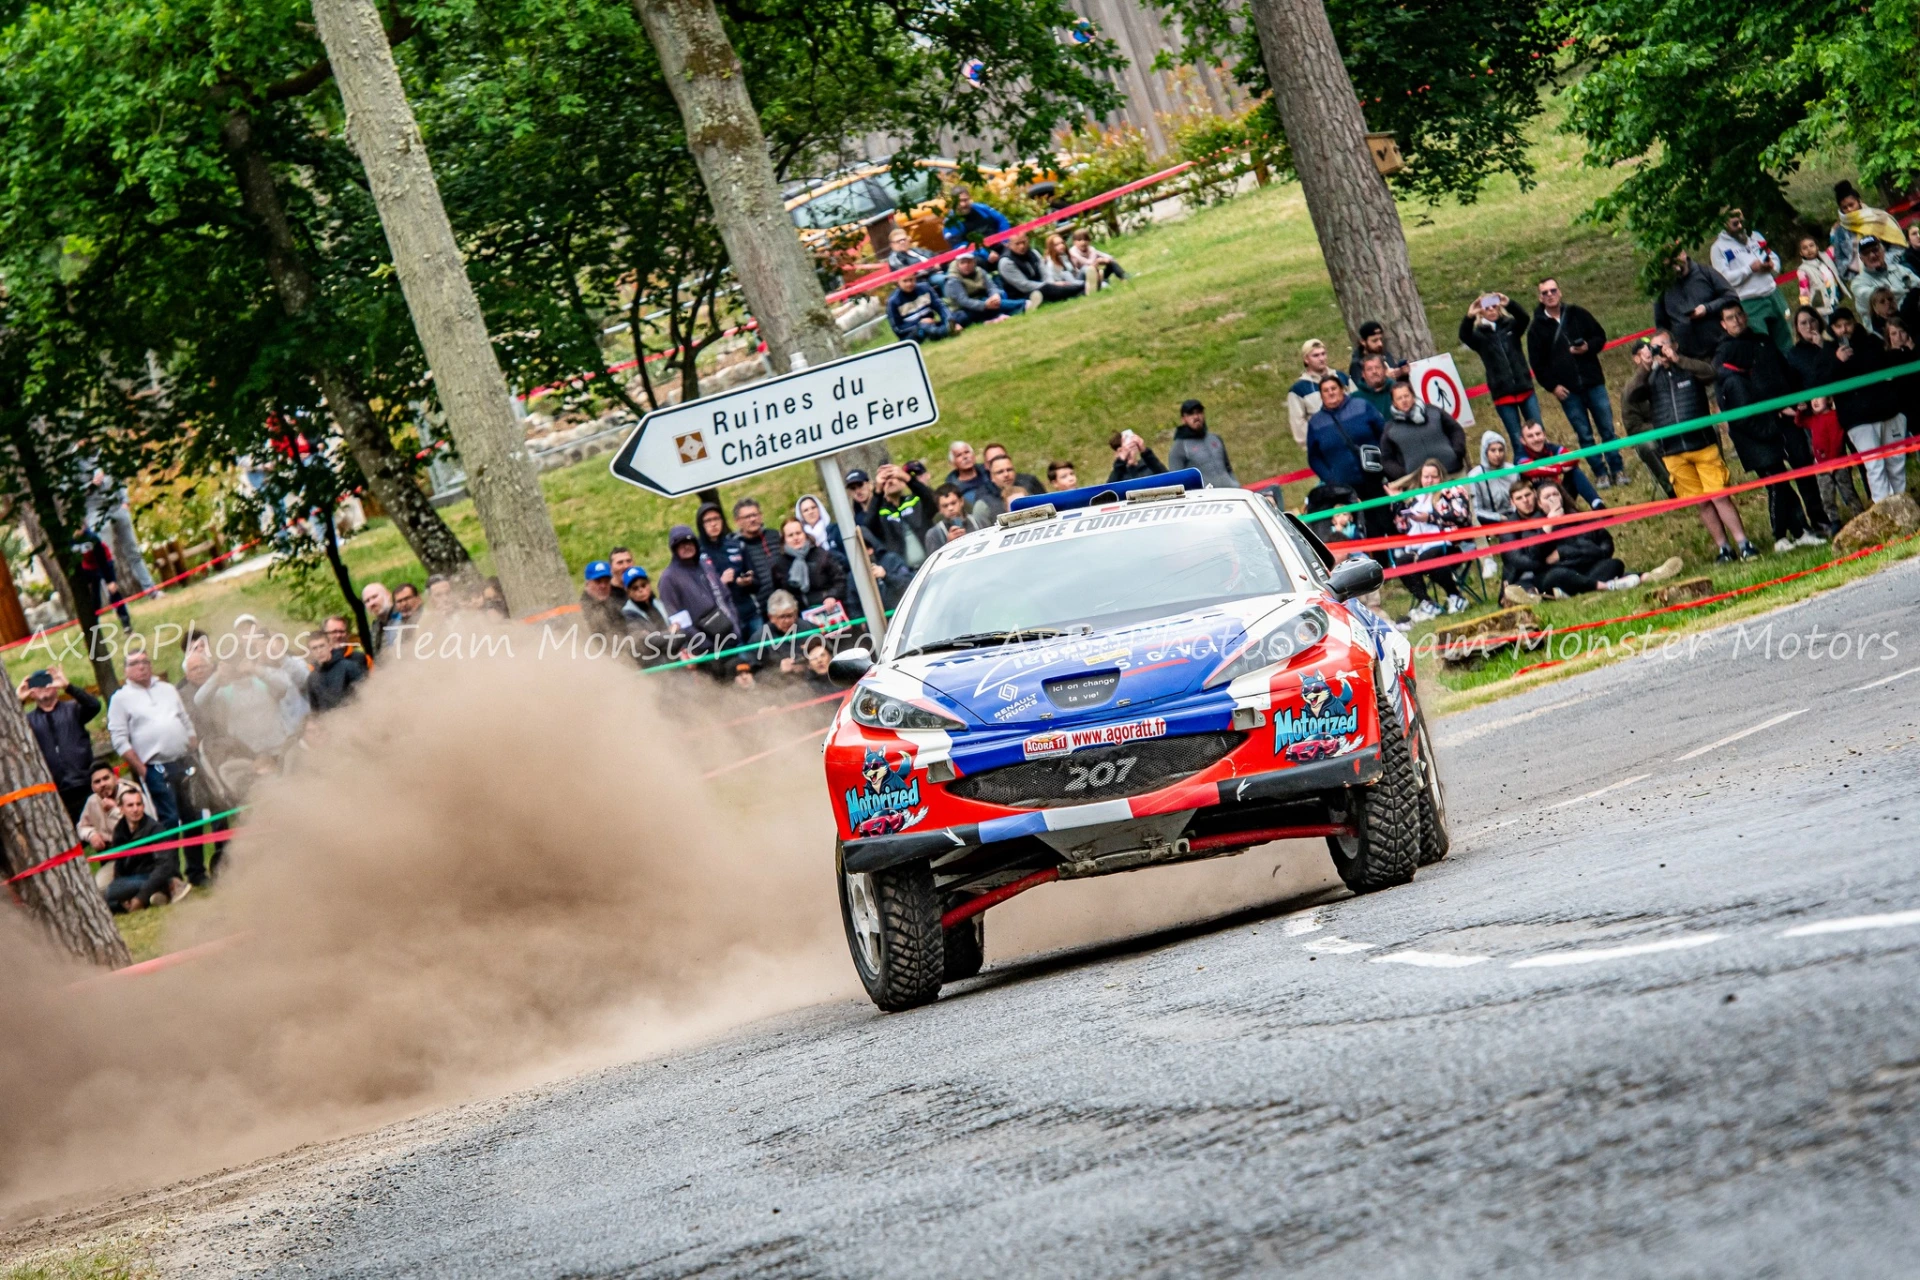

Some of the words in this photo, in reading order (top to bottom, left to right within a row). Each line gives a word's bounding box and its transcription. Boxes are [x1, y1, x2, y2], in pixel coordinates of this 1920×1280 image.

[713, 390, 813, 435] Ruines
[832, 376, 865, 401] du
[721, 423, 823, 466] Château
[831, 409, 859, 435] de
[867, 396, 920, 426] Fère
[948, 540, 991, 560] 43
[1073, 503, 1235, 533] COMPETITIONS
[1082, 677, 1115, 688] change
[993, 693, 1037, 719] RENAULT
[999, 699, 1038, 722] TRUCKS
[1071, 718, 1166, 747] www.agoratt.fr
[1274, 704, 1359, 755] Motorized
[1064, 756, 1138, 792] 207
[845, 777, 920, 832] Motorized
